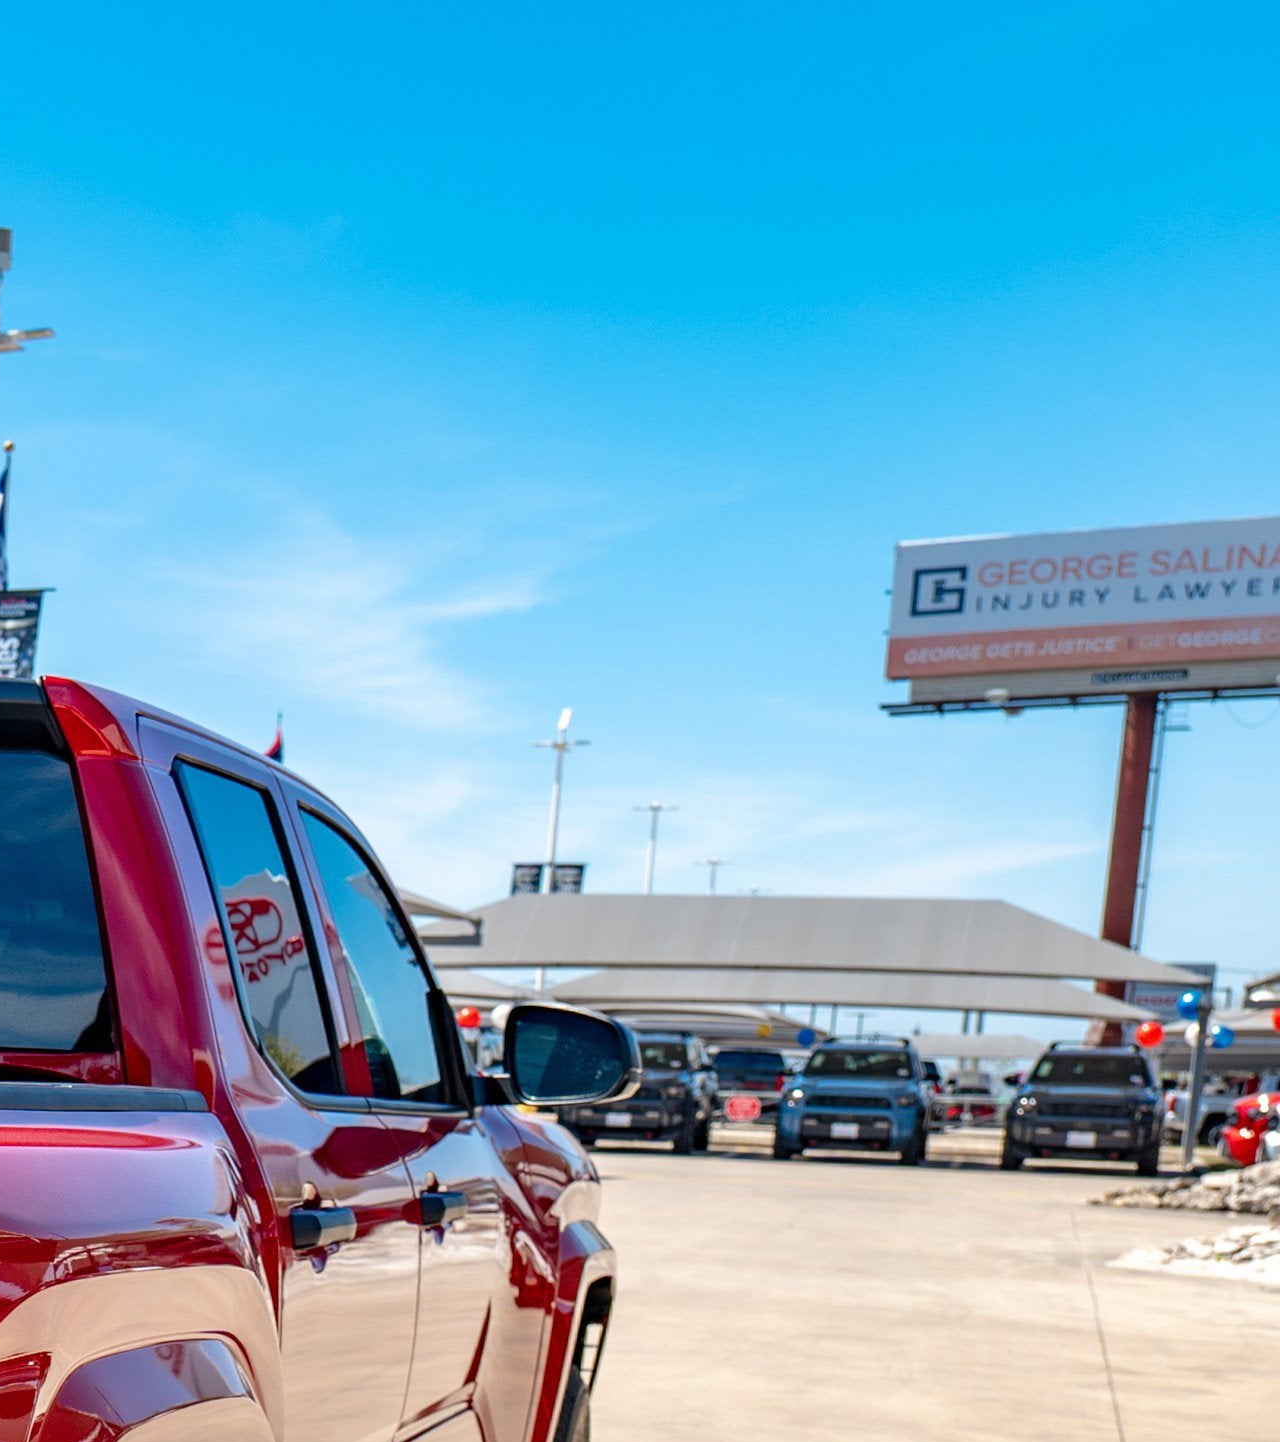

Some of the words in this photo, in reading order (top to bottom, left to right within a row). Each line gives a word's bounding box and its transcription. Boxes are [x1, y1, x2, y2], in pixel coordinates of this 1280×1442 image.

[976, 551, 1138, 588] GEORGE
[974, 586, 1111, 613] INJURY
[903, 643, 983, 665] GEORGE
[985, 640, 1037, 660] GETS
[1038, 635, 1121, 657] JUSTICE
